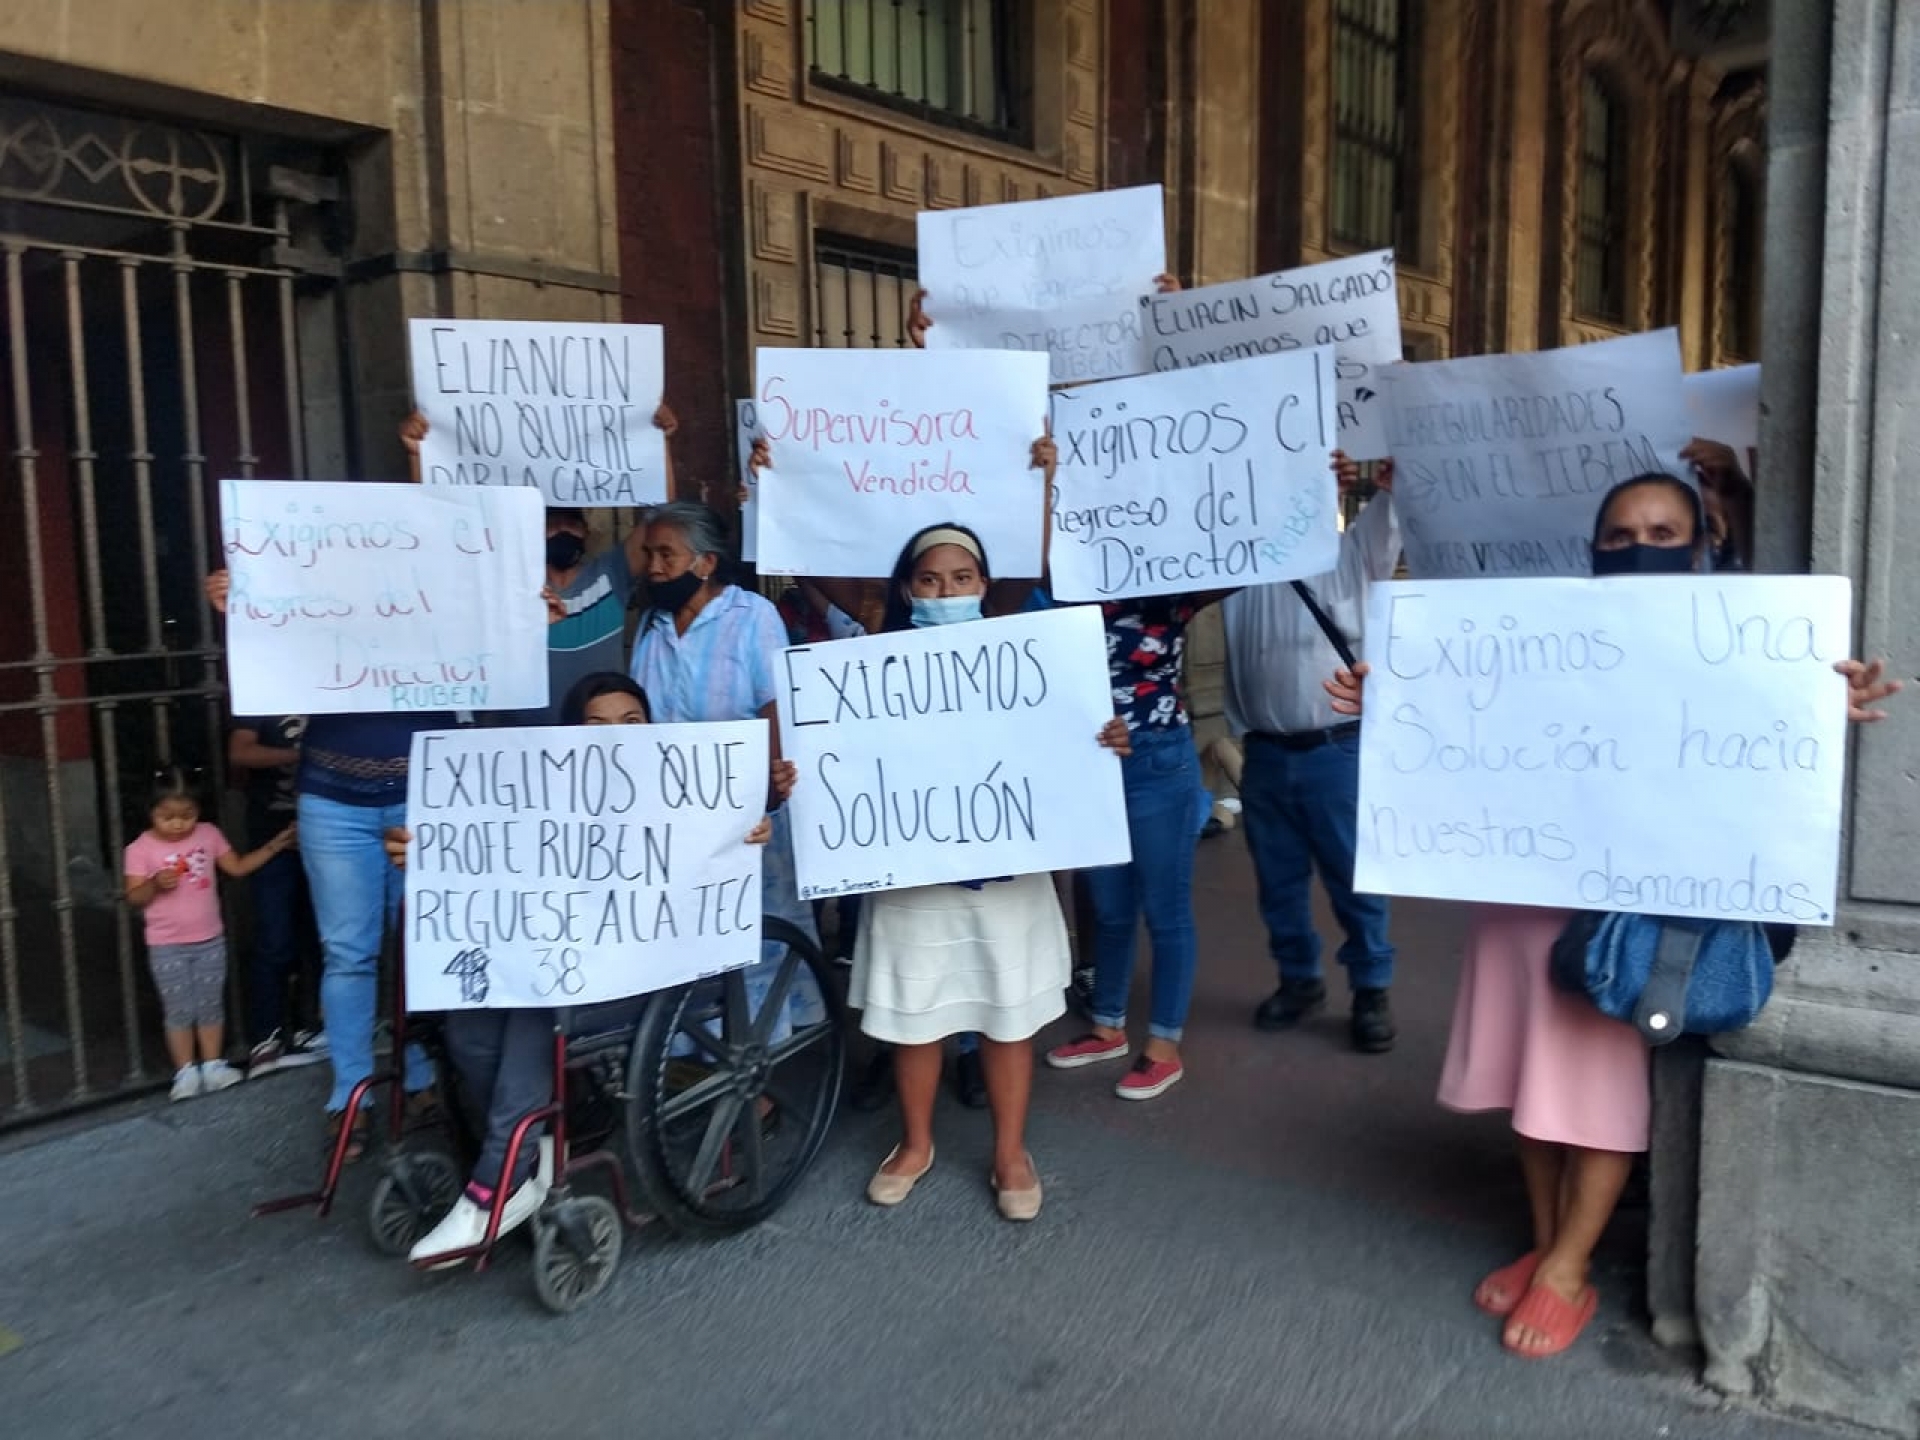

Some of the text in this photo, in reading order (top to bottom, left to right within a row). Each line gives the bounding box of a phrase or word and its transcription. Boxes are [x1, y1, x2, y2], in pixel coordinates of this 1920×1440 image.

[430, 327, 631, 402] ELIANCIN
[1000, 309, 1143, 352] DIRECTOR
[1050, 349, 1124, 379] UBEN
[455, 400, 645, 473] NO QUIERE
[761, 376, 979, 450] Supervisora
[1275, 351, 1326, 453] el
[552, 466, 636, 503] CARA
[843, 449, 977, 496] Vendida
[1194, 458, 1258, 532] del
[1440, 456, 1483, 502] EN
[1489, 450, 1526, 498] EL
[222, 481, 495, 568] Exigimos el
[1091, 532, 1266, 595] Director
[784, 637, 1048, 727] EXIGUIMOS
[1383, 590, 1825, 712] Exigimos Una
[390, 684, 491, 710] RUBEN
[1391, 698, 1820, 774] Solución hacia
[421, 736, 746, 817] EXIGIMOS QUE
[416, 818, 672, 887] PROFE RUBEN
[414, 887, 591, 949] REGUESE
[691, 873, 755, 937] TEC
[530, 947, 587, 998] 38
